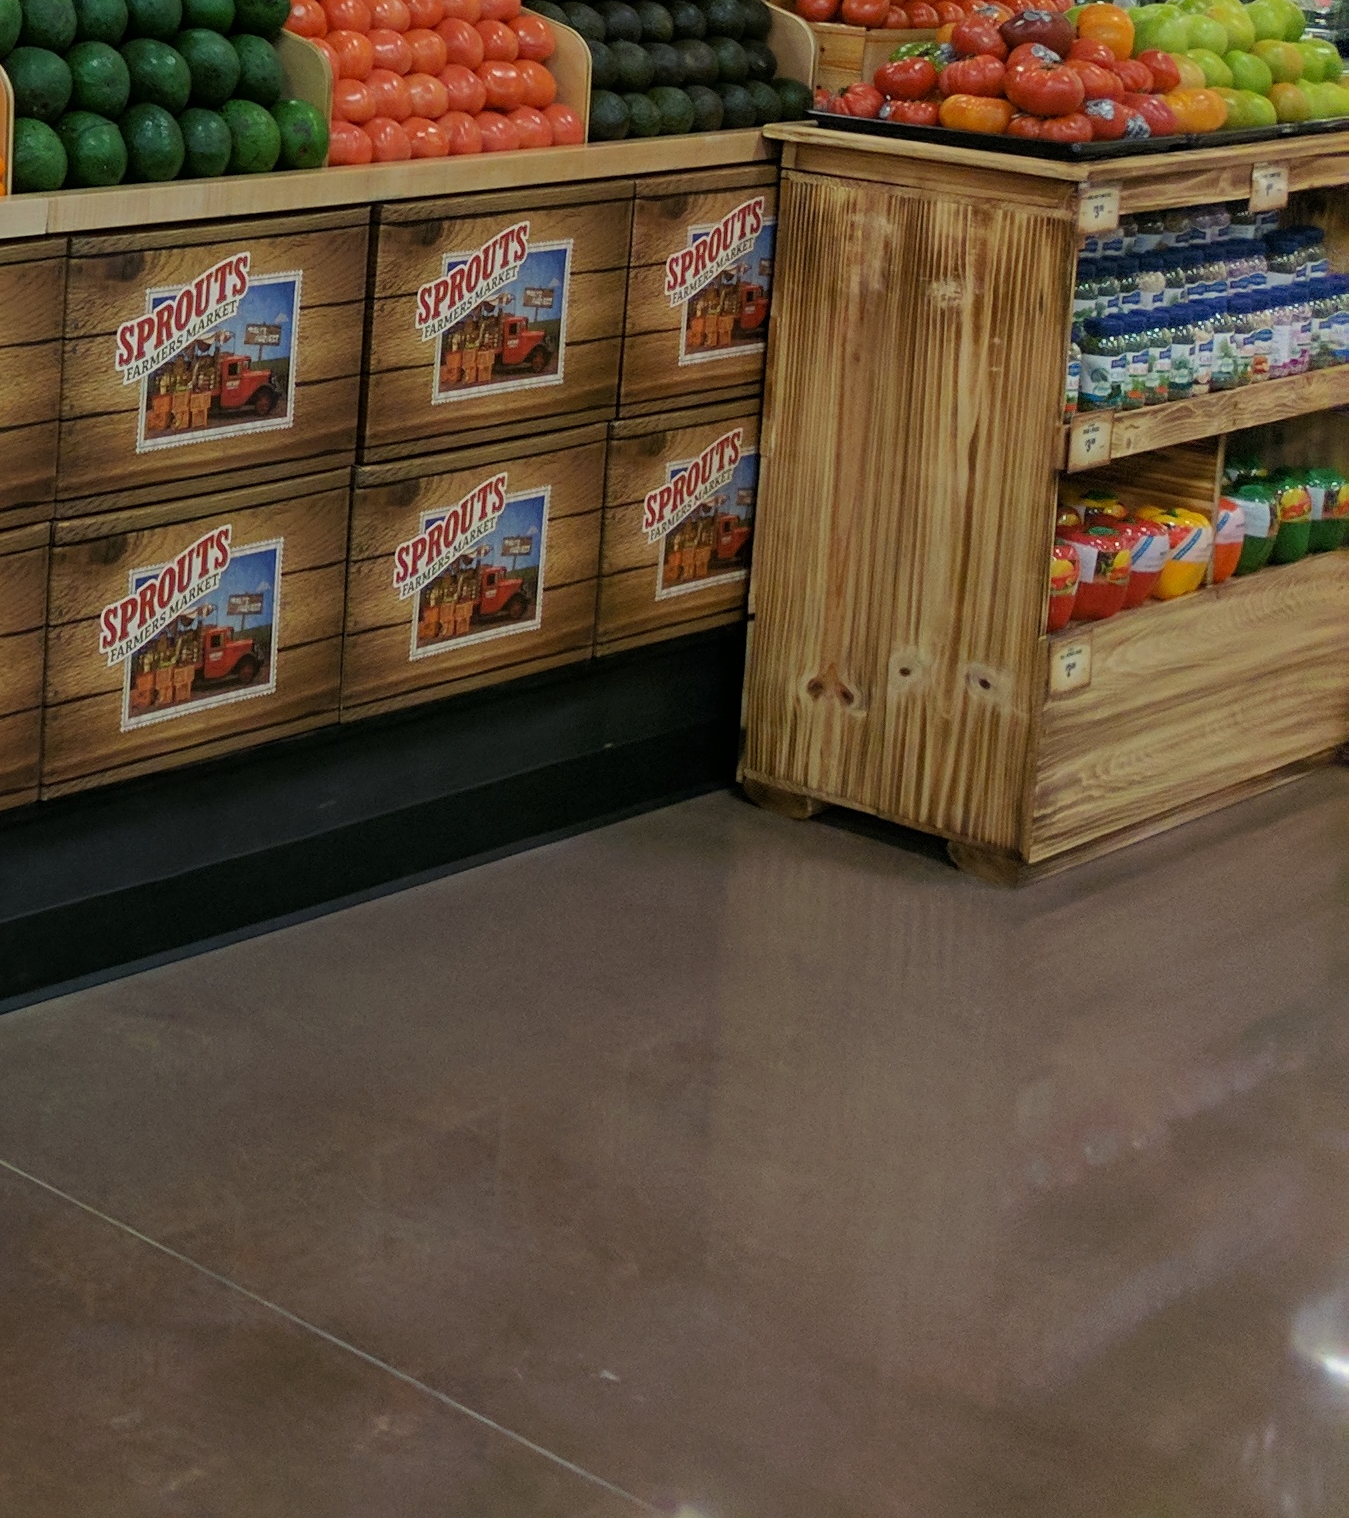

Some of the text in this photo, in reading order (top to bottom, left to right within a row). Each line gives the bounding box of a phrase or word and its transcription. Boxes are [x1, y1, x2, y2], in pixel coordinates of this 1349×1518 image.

[418, 224, 528, 326] SPROUTS
[667, 199, 762, 292] SPROUTS
[672, 237, 754, 304] FARMERS MARKET
[118, 255, 248, 367] SPROUTS
[126, 299, 238, 382] FARMERS MARKET
[424, 265, 518, 339] FARMERS MARKET
[645, 430, 741, 529] SPROUTS
[396, 475, 506, 584] SPROUTS
[402, 516, 497, 597] FARMERS MARKET
[102, 528, 230, 650] SPROUTS
[109, 572, 221, 664] FARMERS MARKET
